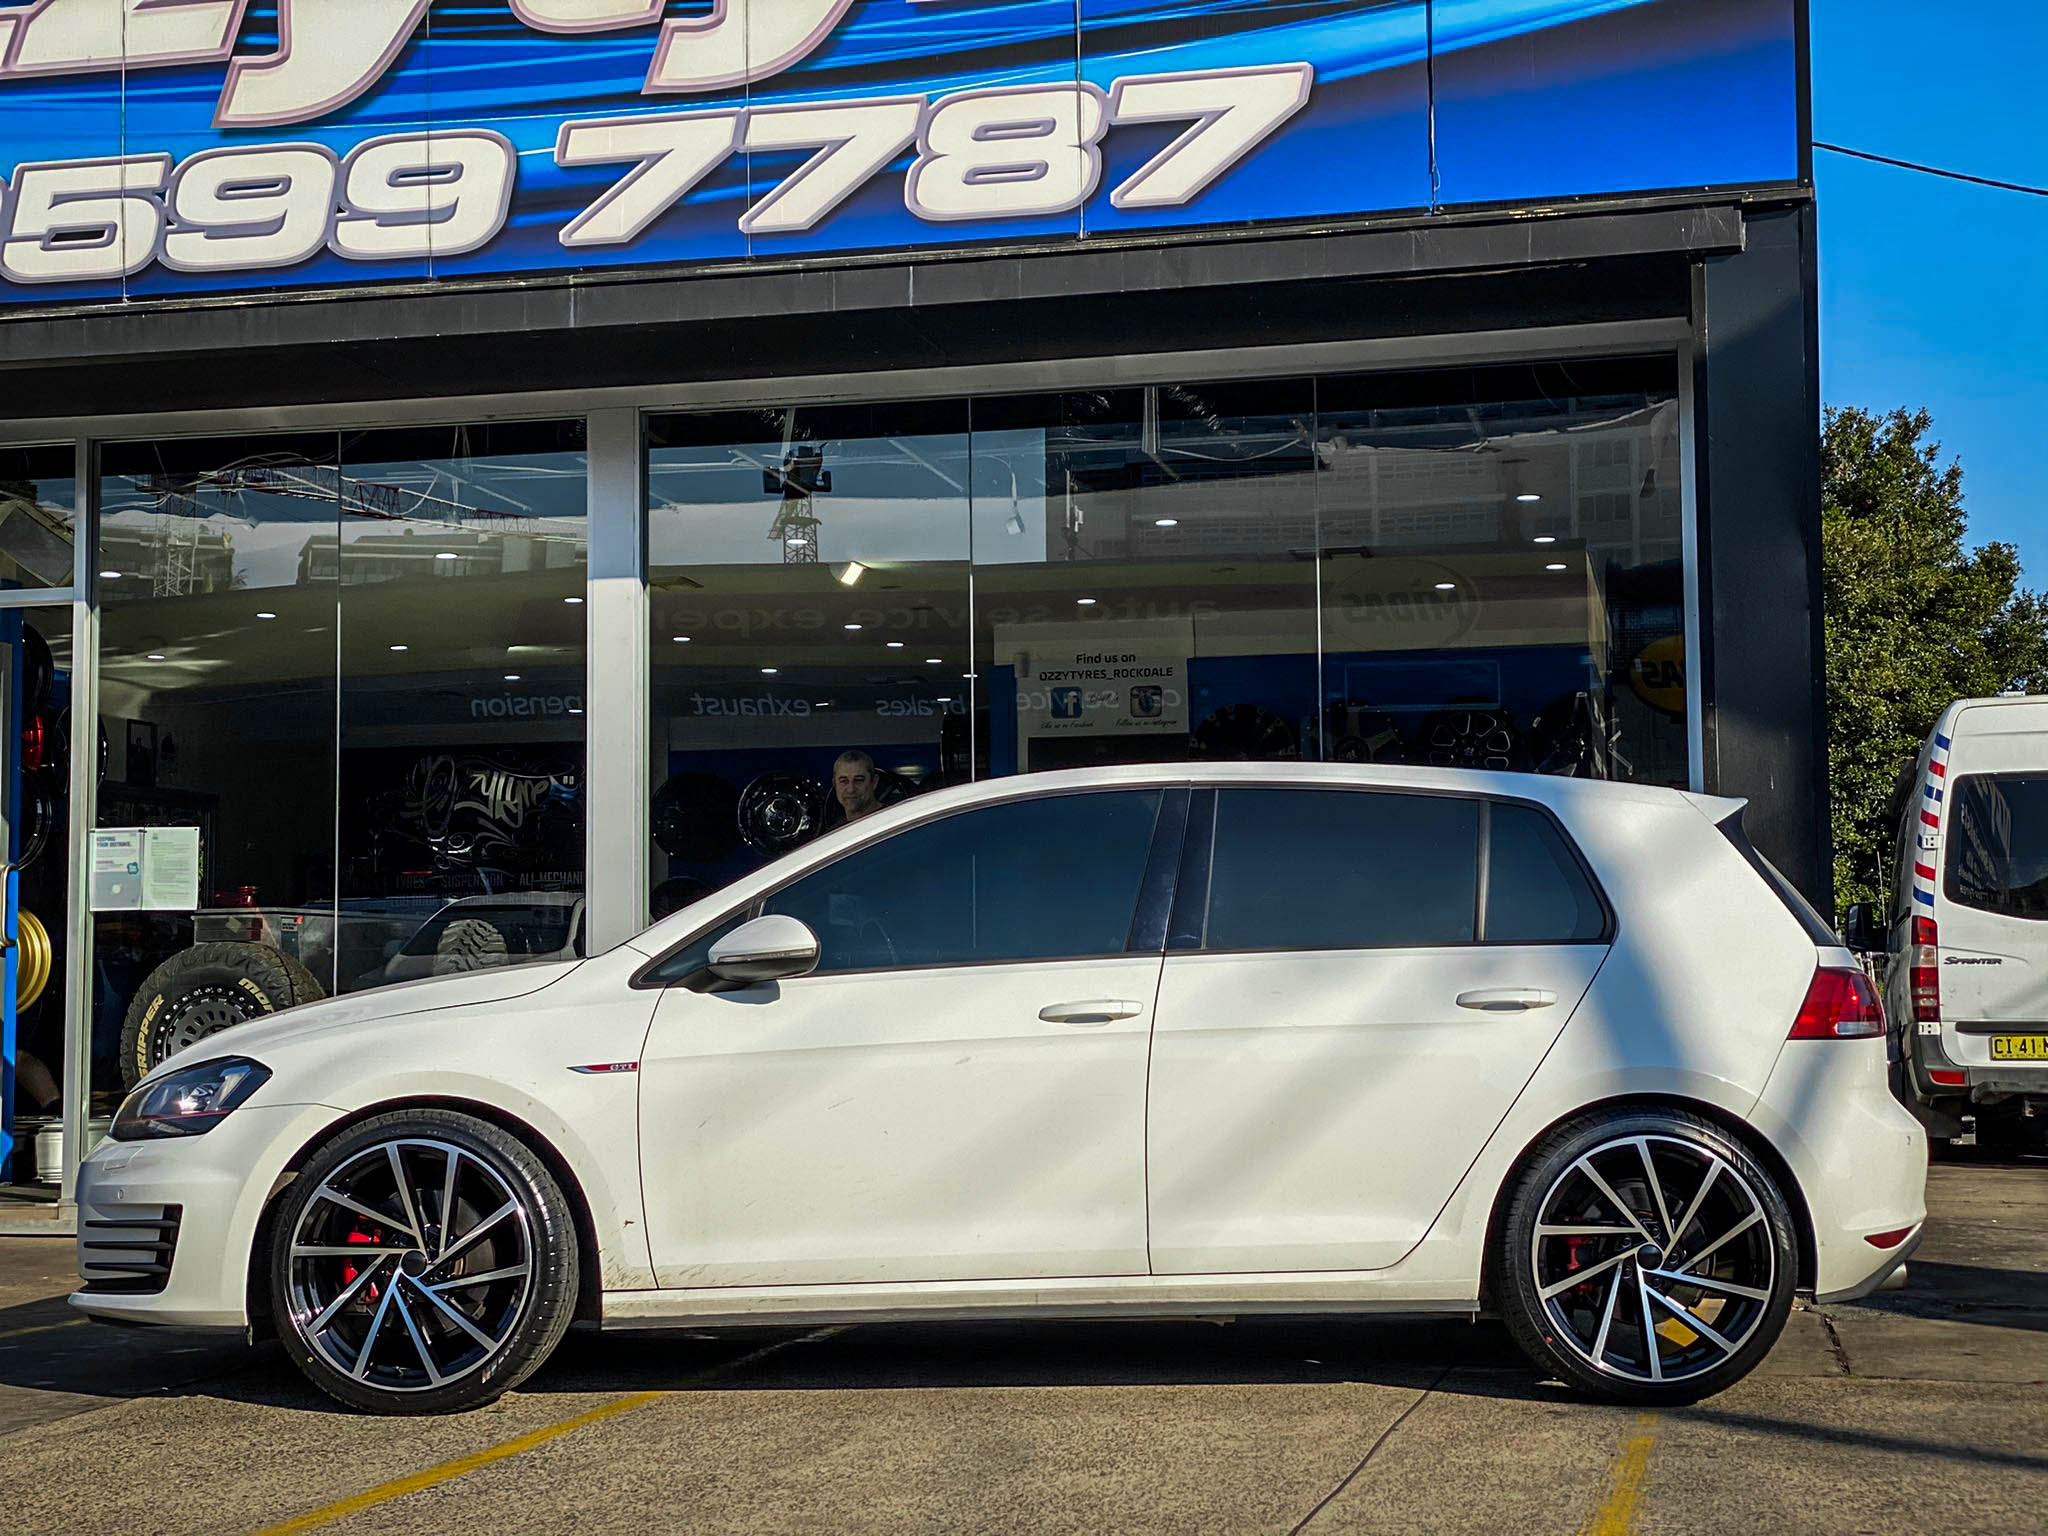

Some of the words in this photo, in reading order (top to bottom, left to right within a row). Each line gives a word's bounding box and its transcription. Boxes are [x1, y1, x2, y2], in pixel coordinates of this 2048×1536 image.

[0, 128, 517, 285] 599
[553, 61, 1314, 248] 7787
[1076, 653, 1101, 665] Find
[1104, 654, 1118, 664] us
[1121, 653, 1136, 664] on
[1039, 667, 1173, 681] OZZYTYRES_ROCKDALE
